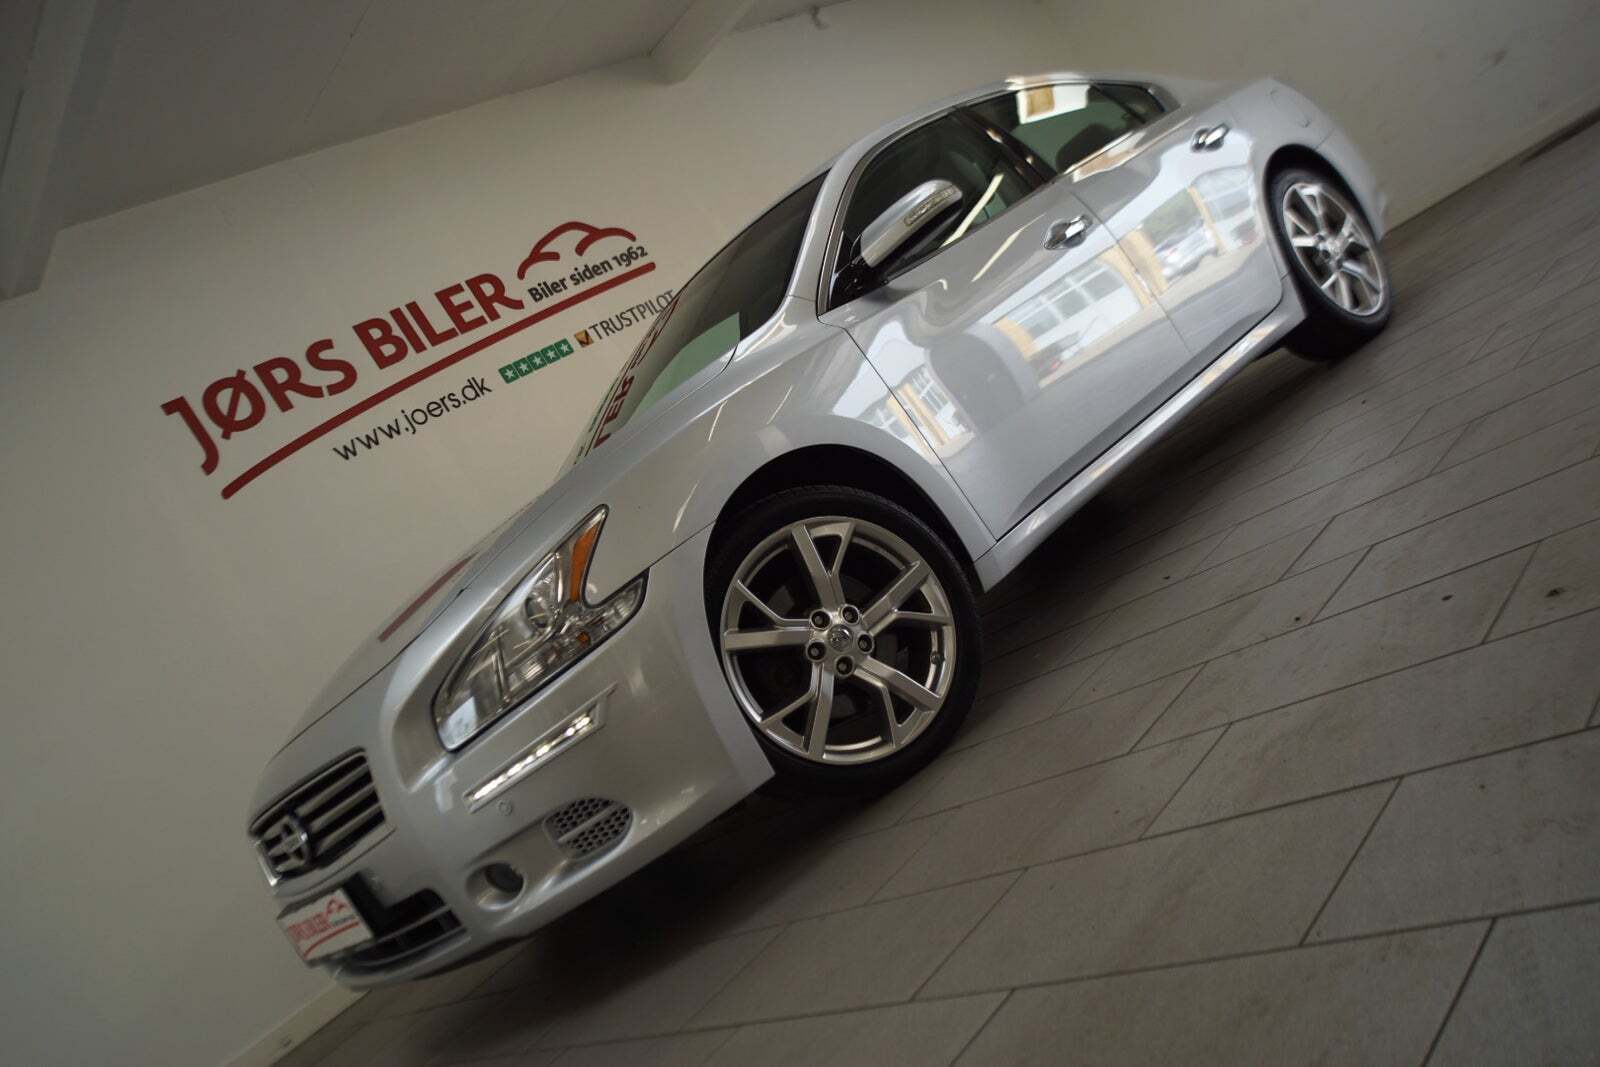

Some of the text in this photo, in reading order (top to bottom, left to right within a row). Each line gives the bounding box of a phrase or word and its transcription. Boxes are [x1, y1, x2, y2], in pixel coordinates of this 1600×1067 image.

[528, 245, 648, 303] Biler siden 1962
[161, 272, 525, 475] JØRS BILER
[333, 375, 493, 461] www.joers.dk
